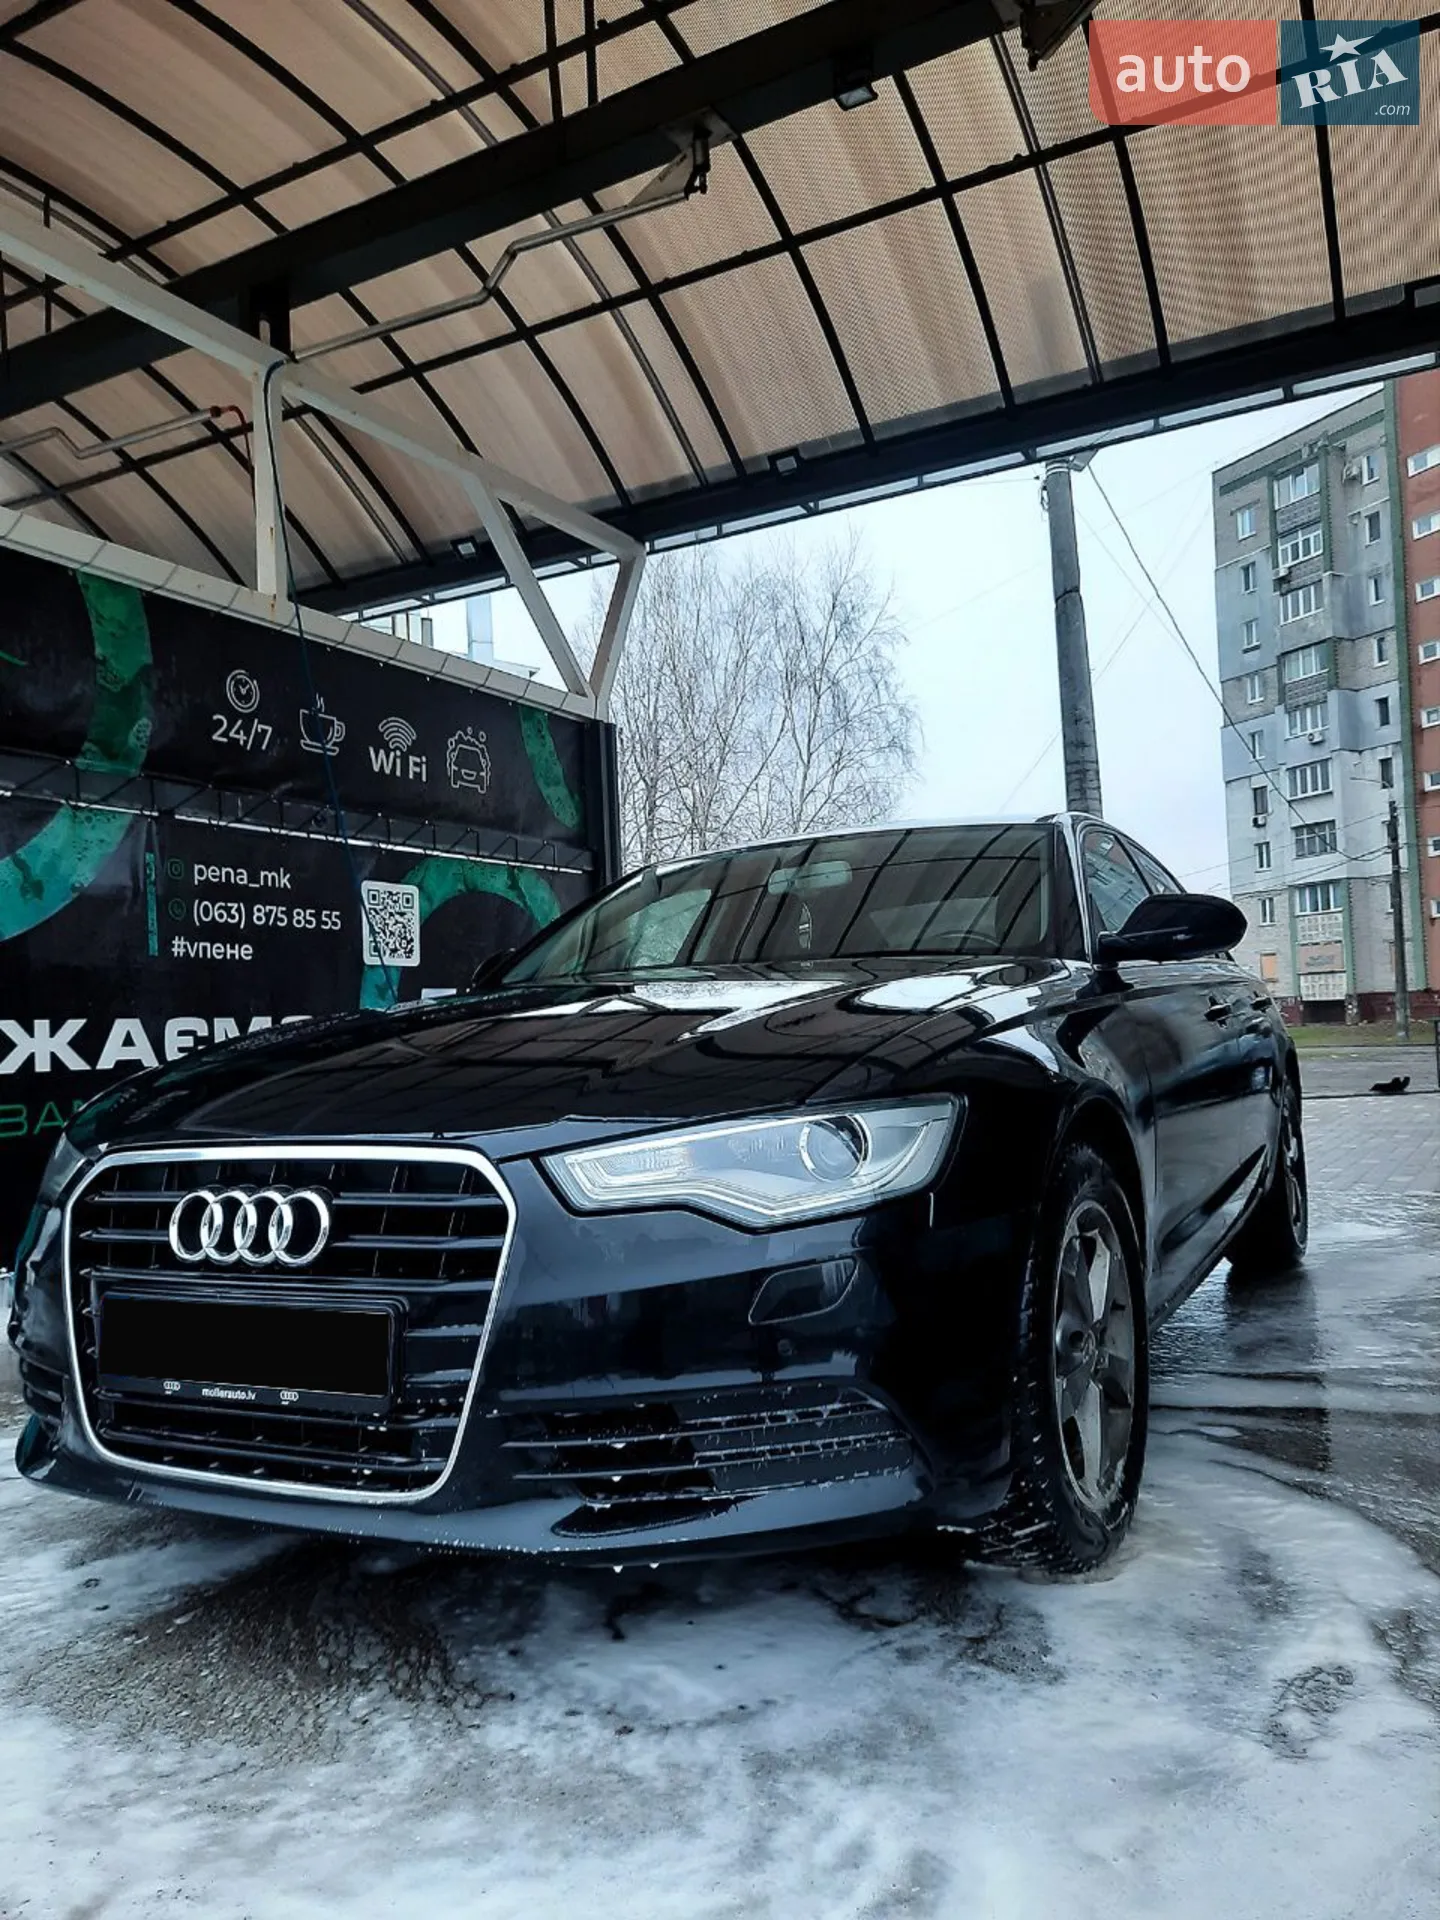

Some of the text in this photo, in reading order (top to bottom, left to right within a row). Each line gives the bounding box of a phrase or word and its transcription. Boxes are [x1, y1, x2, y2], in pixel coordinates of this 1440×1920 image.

[211, 714, 273, 750] 24/7
[194, 863, 292, 889] pena_mk
[193, 899, 342, 930] (063) 875 85 55
